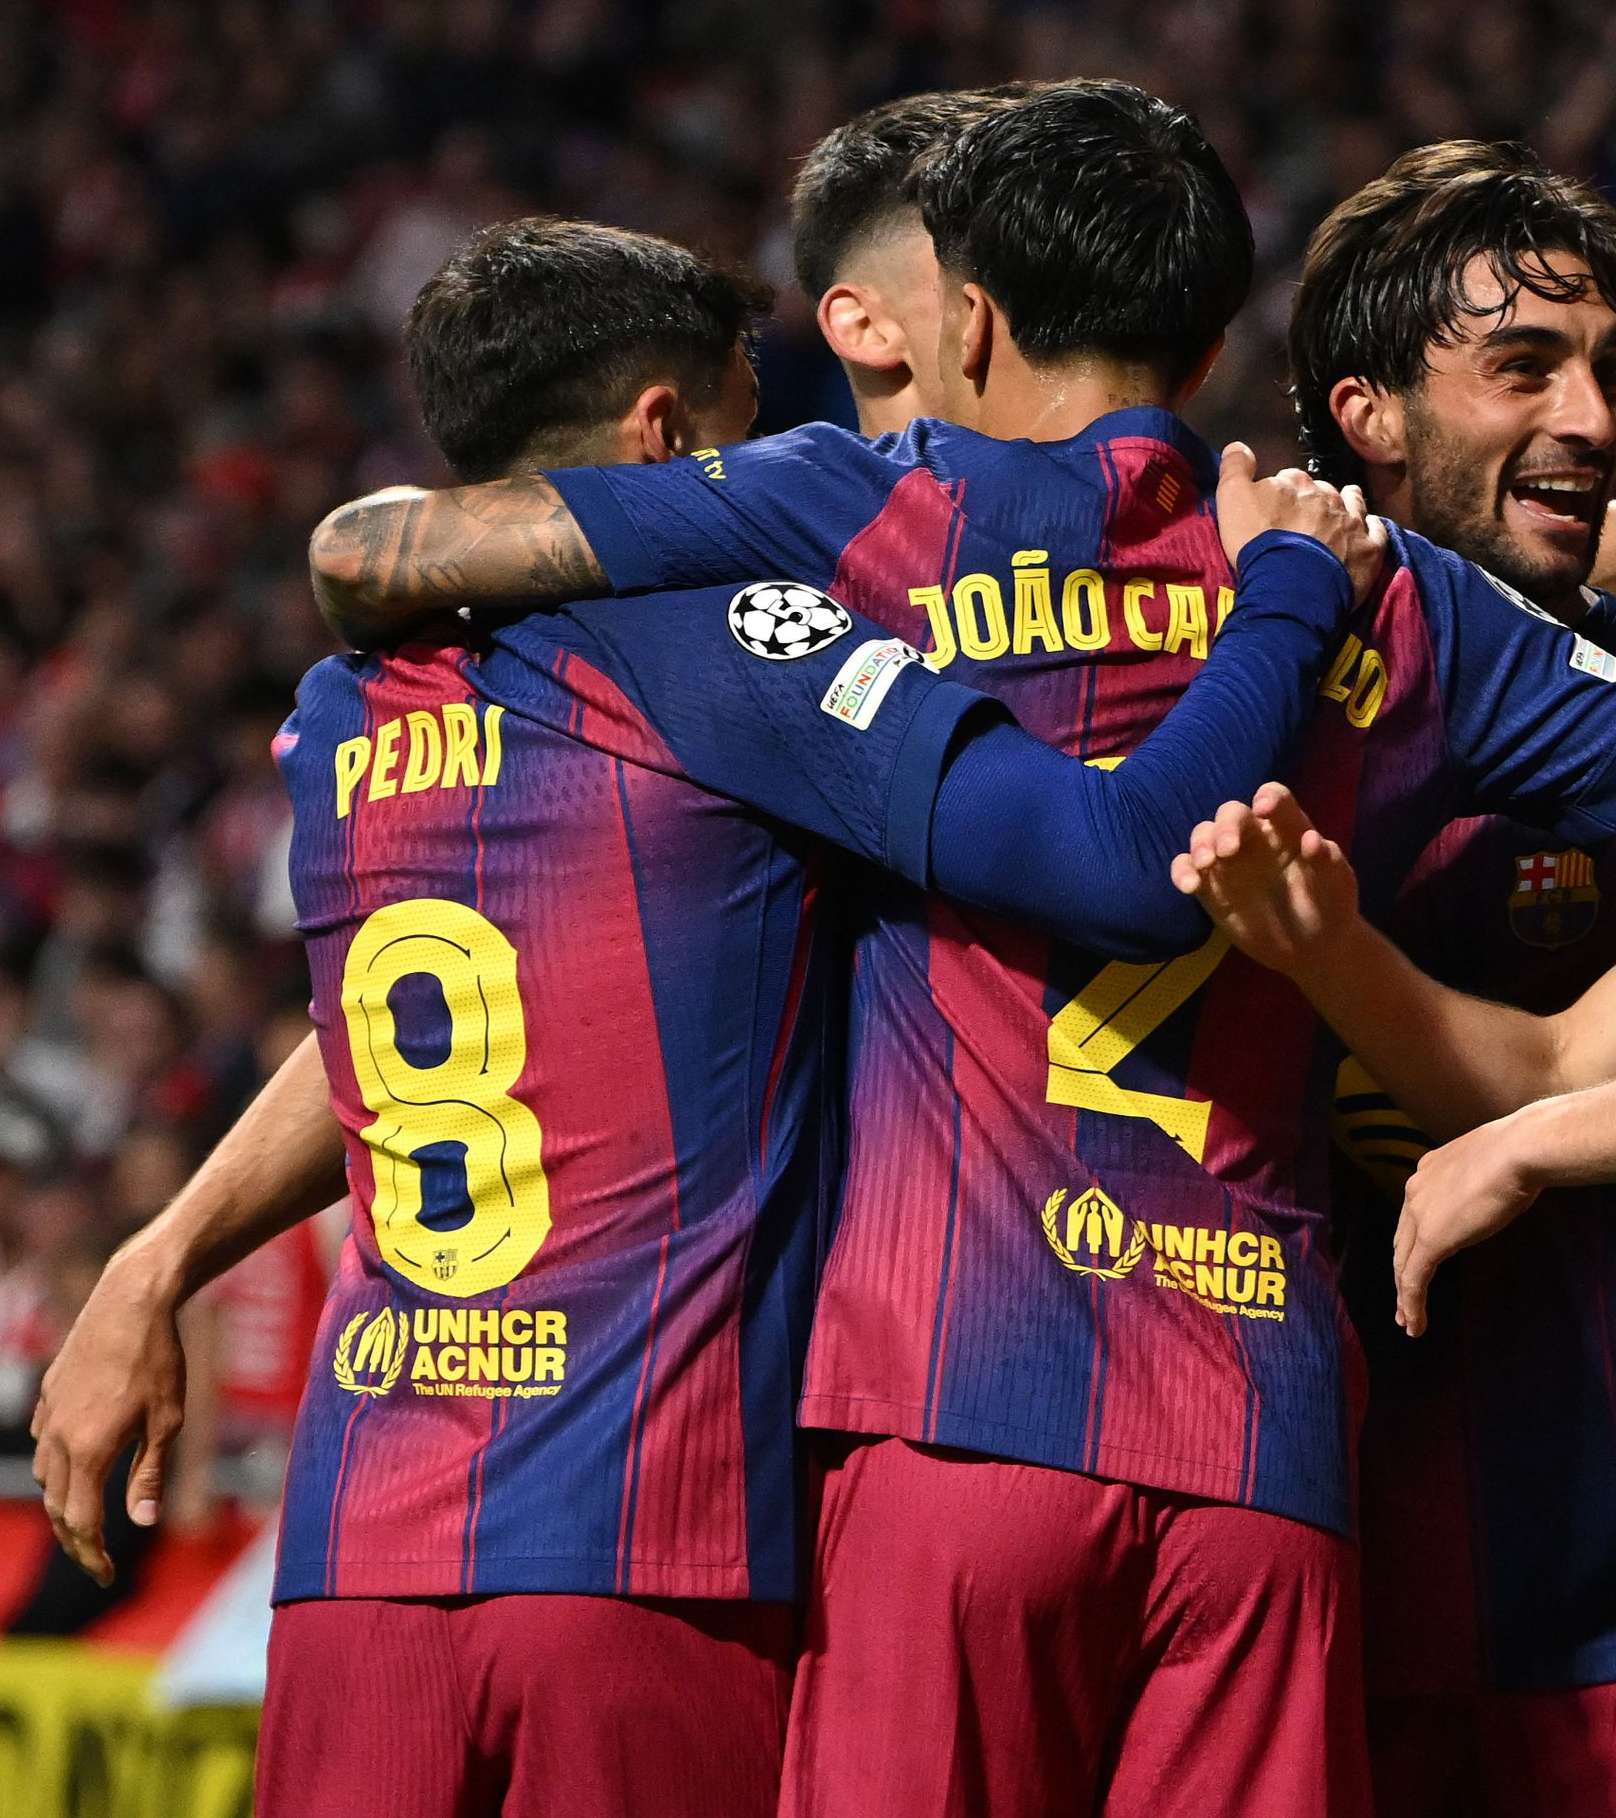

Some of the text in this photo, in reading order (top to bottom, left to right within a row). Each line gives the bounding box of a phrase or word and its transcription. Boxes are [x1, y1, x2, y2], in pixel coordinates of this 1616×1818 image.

[907, 550, 1112, 670] JOÃO
[827, 684, 845, 711] UEFA
[840, 646, 899, 718] FOUNDATIO
[335, 703, 506, 820] PEDRI
[341, 898, 553, 1299] 8
[1154, 1274, 1178, 1290] The
[1239, 1304, 1285, 1322] Agency
[413, 1308, 567, 1345] UNHCR
[410, 1345, 567, 1382] ACNUR
[412, 1383, 562, 1400] The UN Refugee Agency
